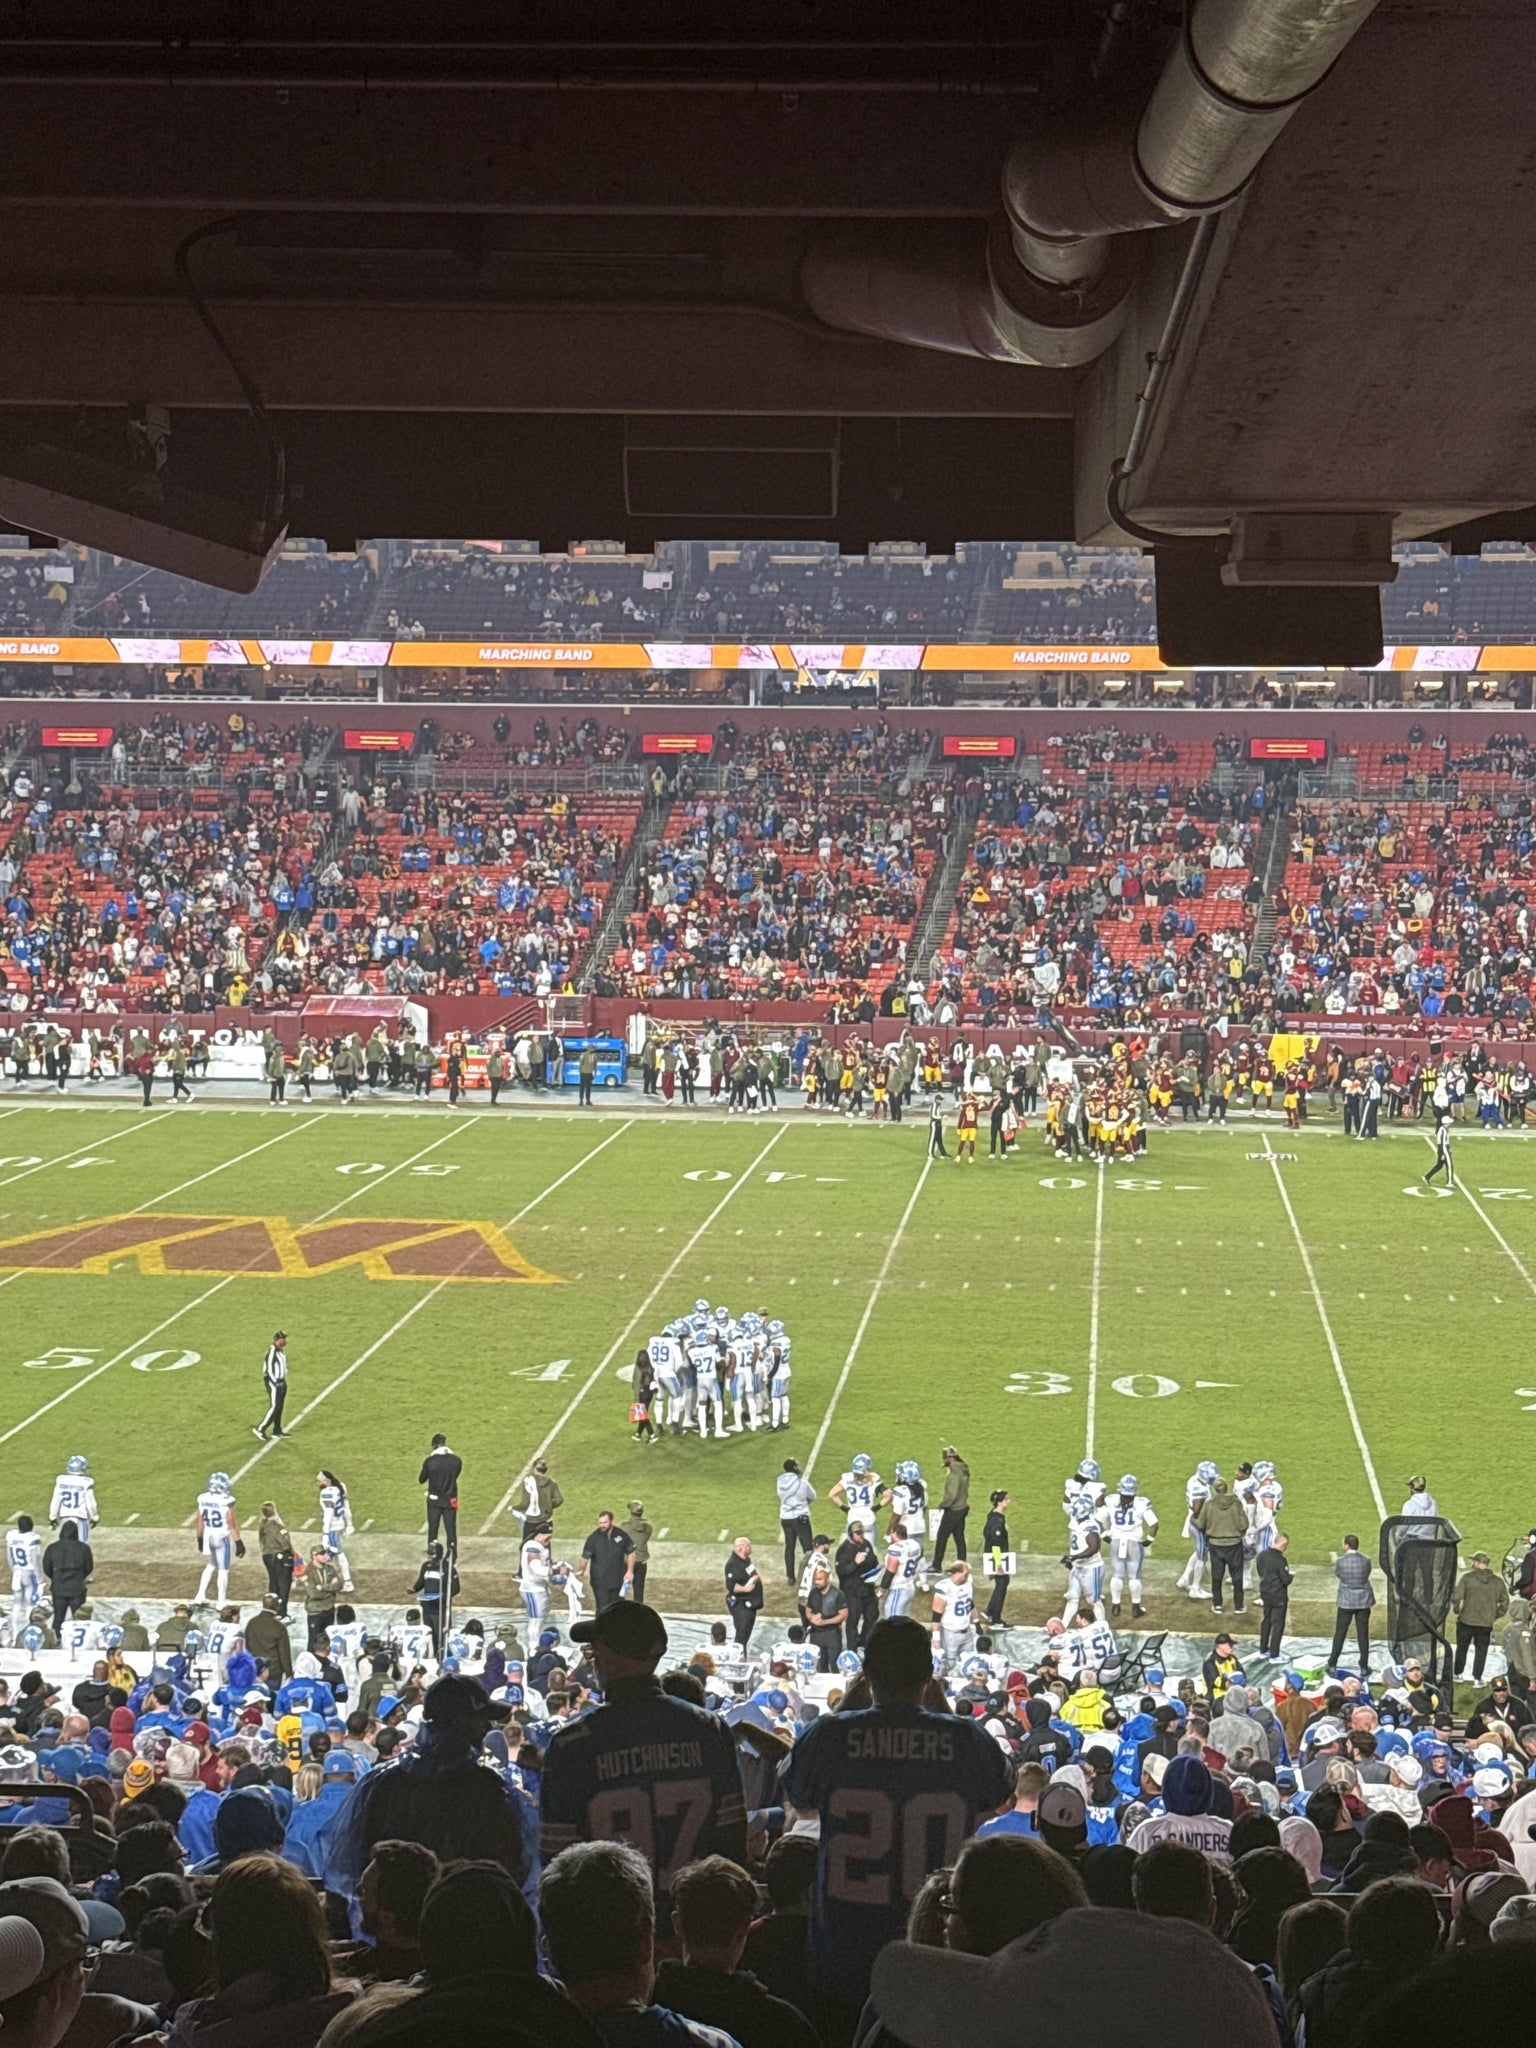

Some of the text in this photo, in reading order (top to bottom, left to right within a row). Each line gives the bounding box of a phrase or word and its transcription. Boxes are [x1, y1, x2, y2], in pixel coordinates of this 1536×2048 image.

[20, 643, 60, 655] BAND
[479, 648, 593, 661] MARCHING BAND
[1012, 651, 1131, 663] MARCHING BAND
[651, 1345, 670, 1362] 99
[693, 1356, 713, 1373] 27
[61, 1491, 80, 1509] 21
[846, 1486, 871, 1505] 34
[202, 1508, 223, 1528] 42
[1114, 1510, 1136, 1526] 81
[9, 1546, 28, 1567] 19
[1091, 1633, 1116, 1659] 57
[847, 1728, 954, 1761] SANDERS
[596, 1741, 702, 1780] HUTCHINSON
[588, 1775, 713, 1891] 97
[827, 1787, 968, 1905] 20
